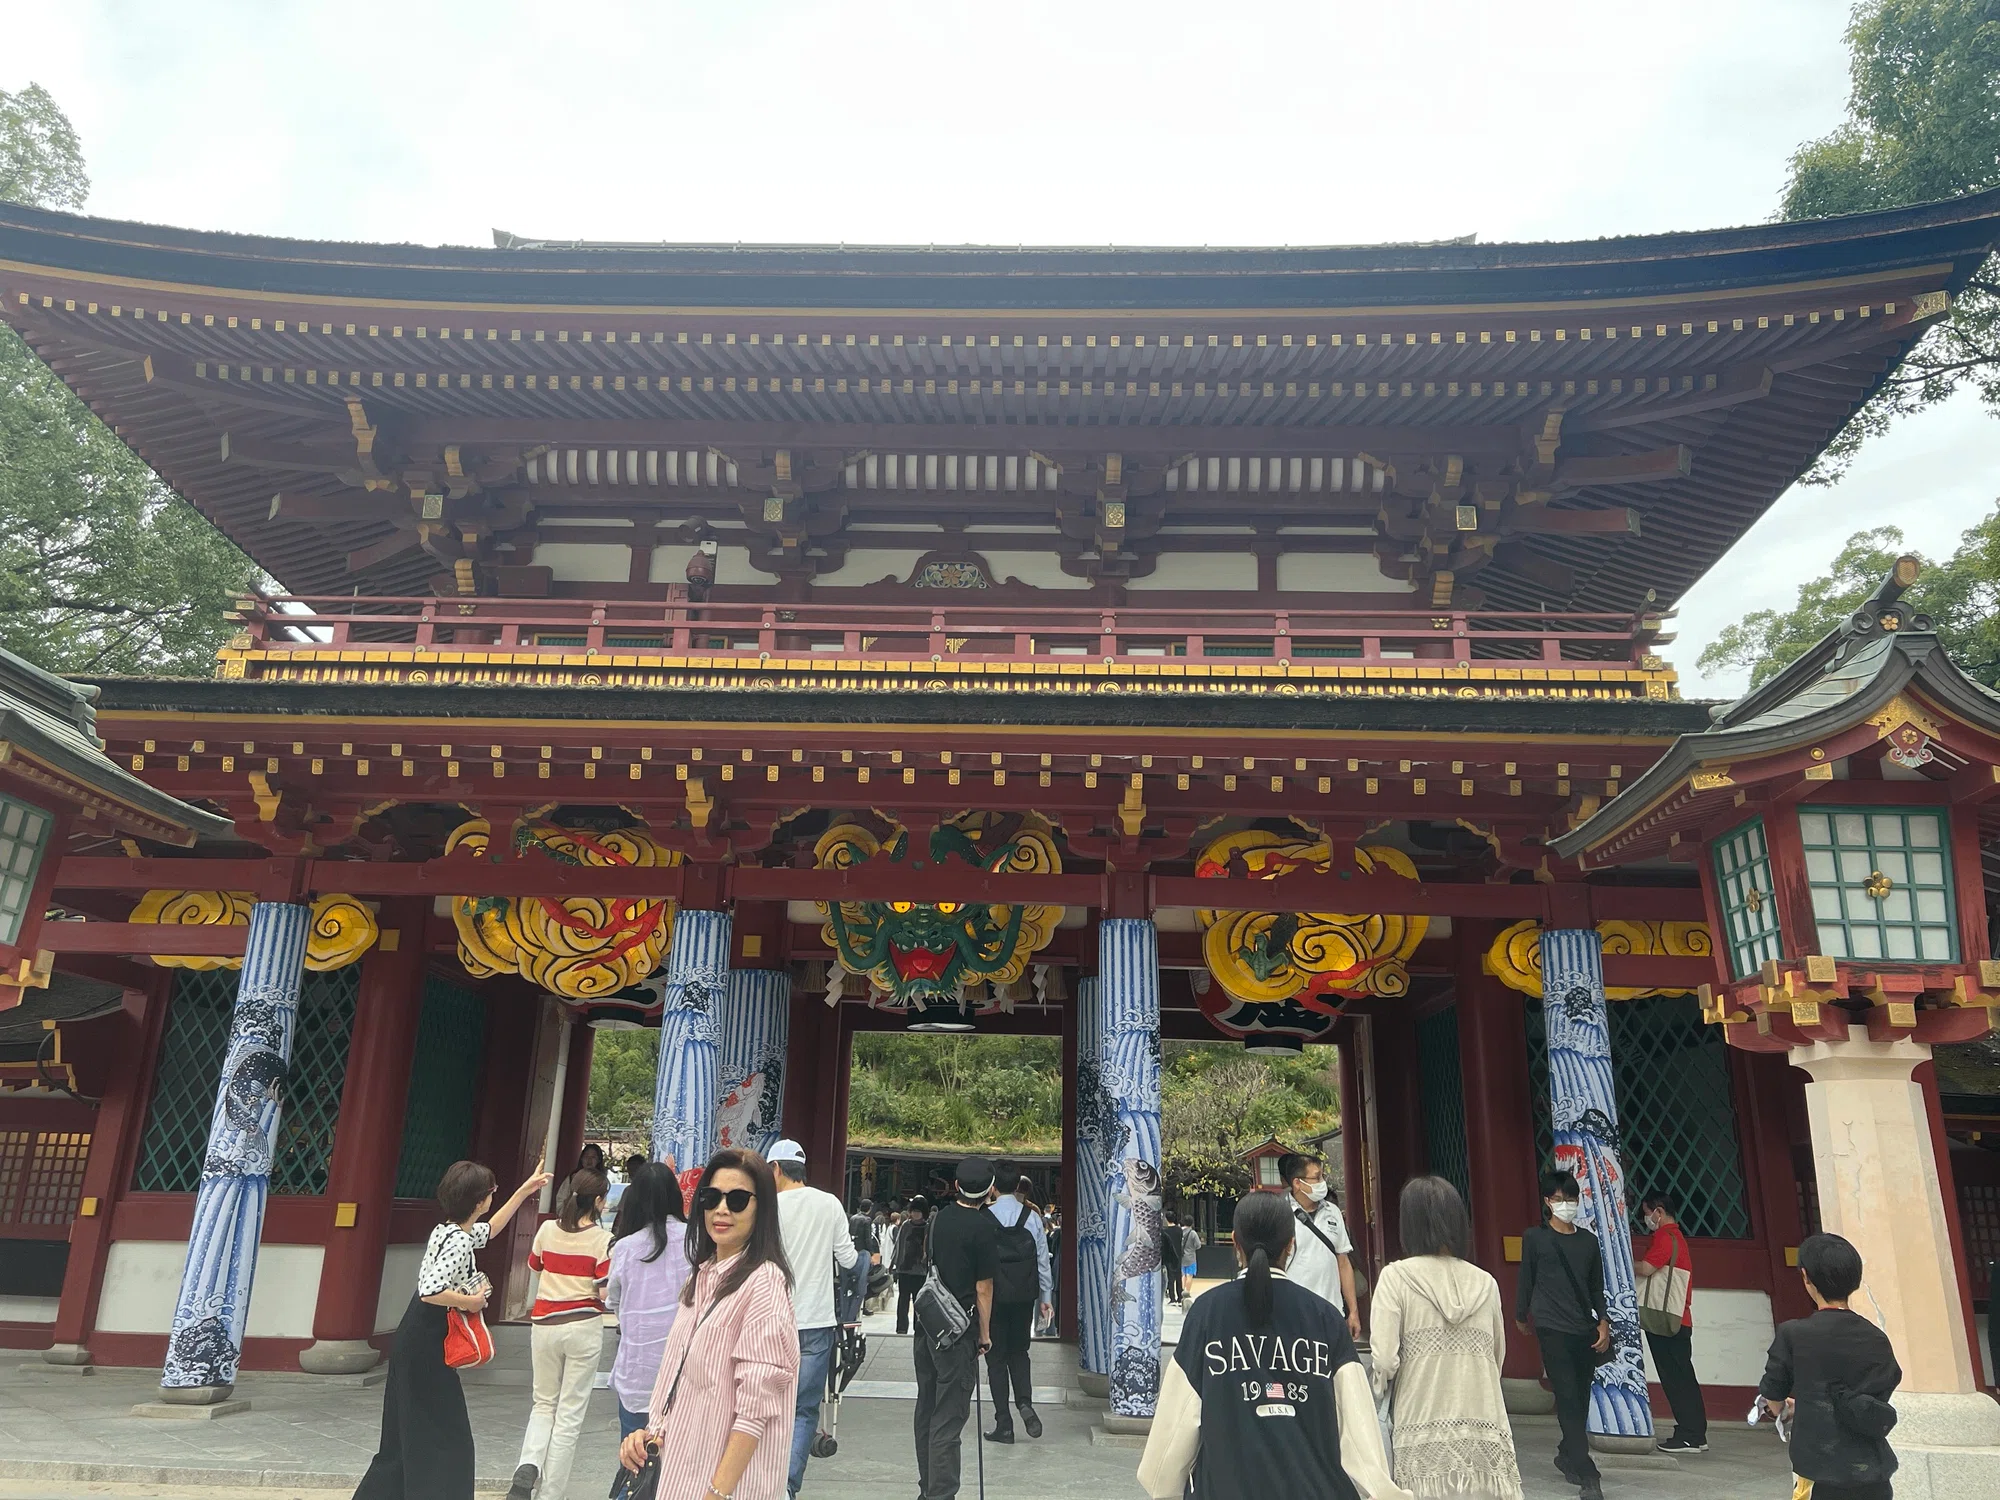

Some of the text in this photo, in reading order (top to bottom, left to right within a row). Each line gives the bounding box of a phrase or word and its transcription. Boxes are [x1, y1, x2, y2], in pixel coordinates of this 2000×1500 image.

[1205, 1334, 1332, 1379] SAVAGE
[1241, 1381, 1309, 1402] 19 85
